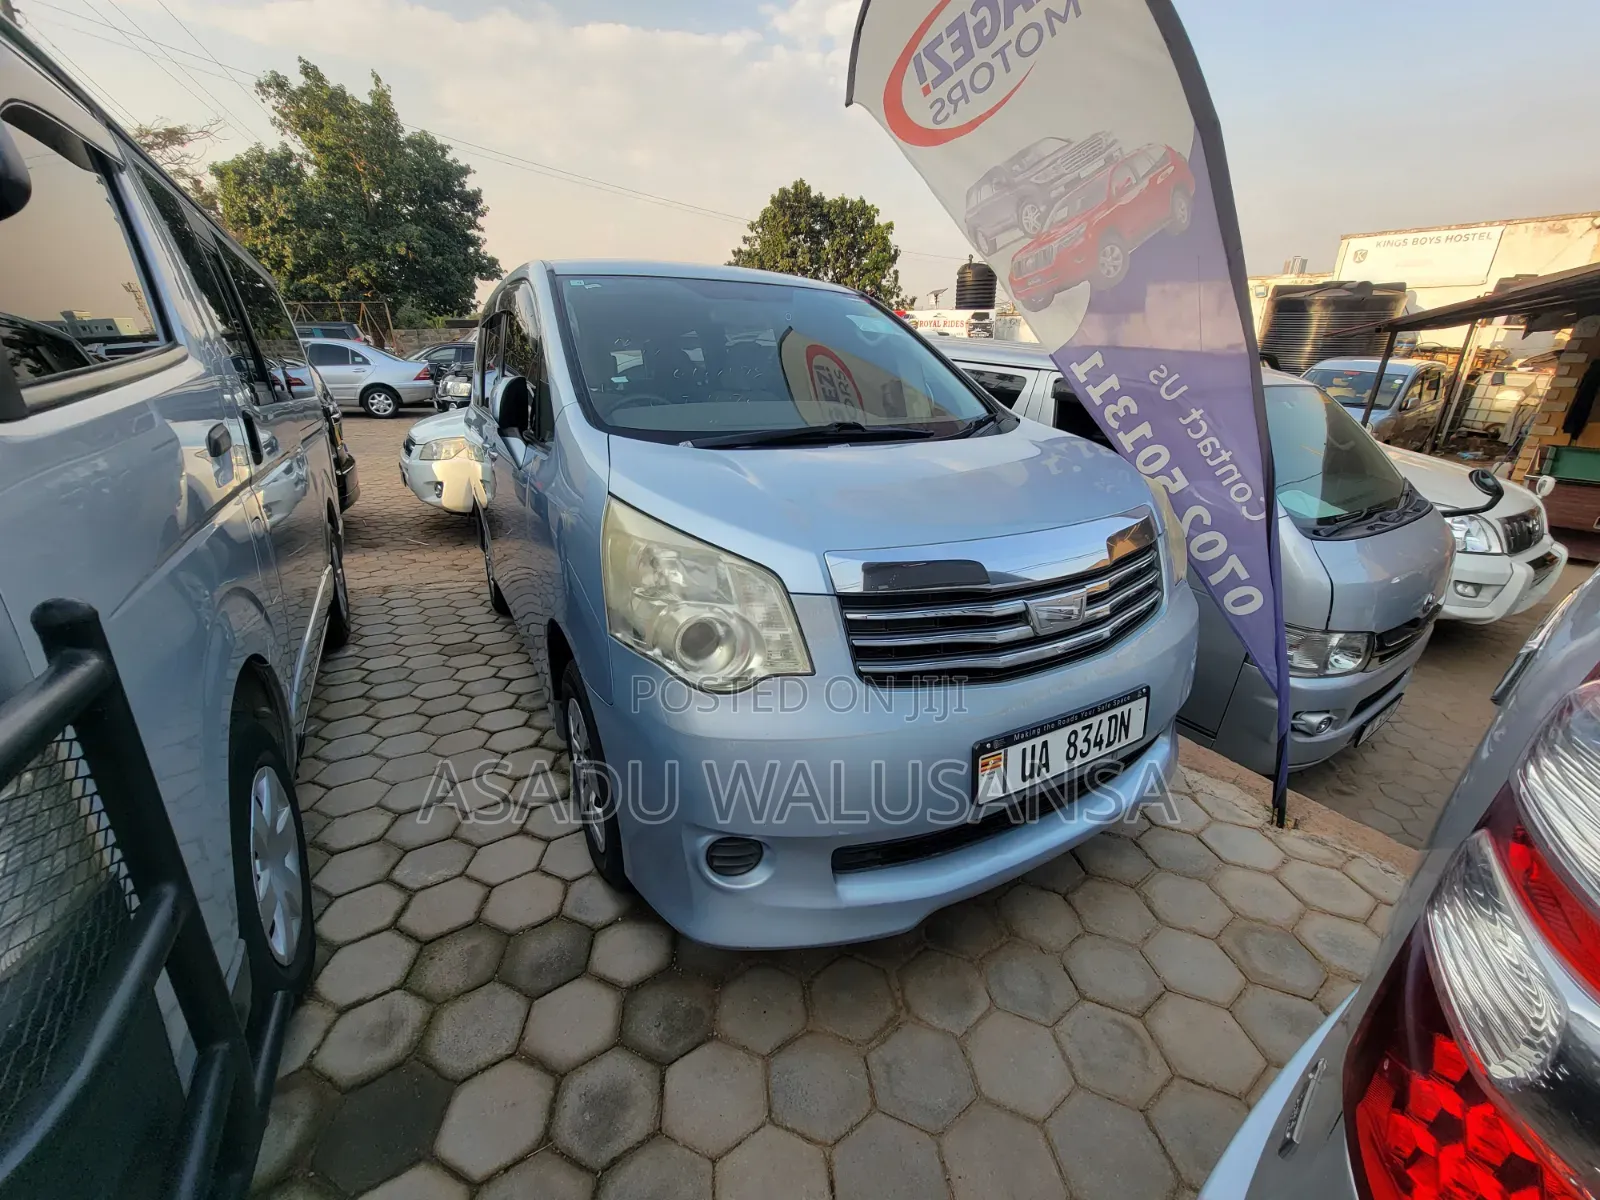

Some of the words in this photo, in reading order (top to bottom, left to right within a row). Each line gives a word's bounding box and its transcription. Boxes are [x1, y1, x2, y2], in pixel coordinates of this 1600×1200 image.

[1375, 237, 1408, 248] KINGS
[1411, 235, 1442, 246] BOYS
[1444, 231, 1493, 244] HOSTEL
[919, 319, 942, 328] ROYAL
[942, 319, 965, 328] RIDES
[1013, 727, 1041, 741] Making
[1043, 722, 1055, 732] the
[1057, 714, 1078, 727] Roads
[1081, 708, 1096, 718] Your
[1097, 701, 1111, 712] Safe
[1113, 695, 1131, 707] Space
[1021, 740, 1050, 783] UA
[1065, 708, 1132, 763] 834DN
